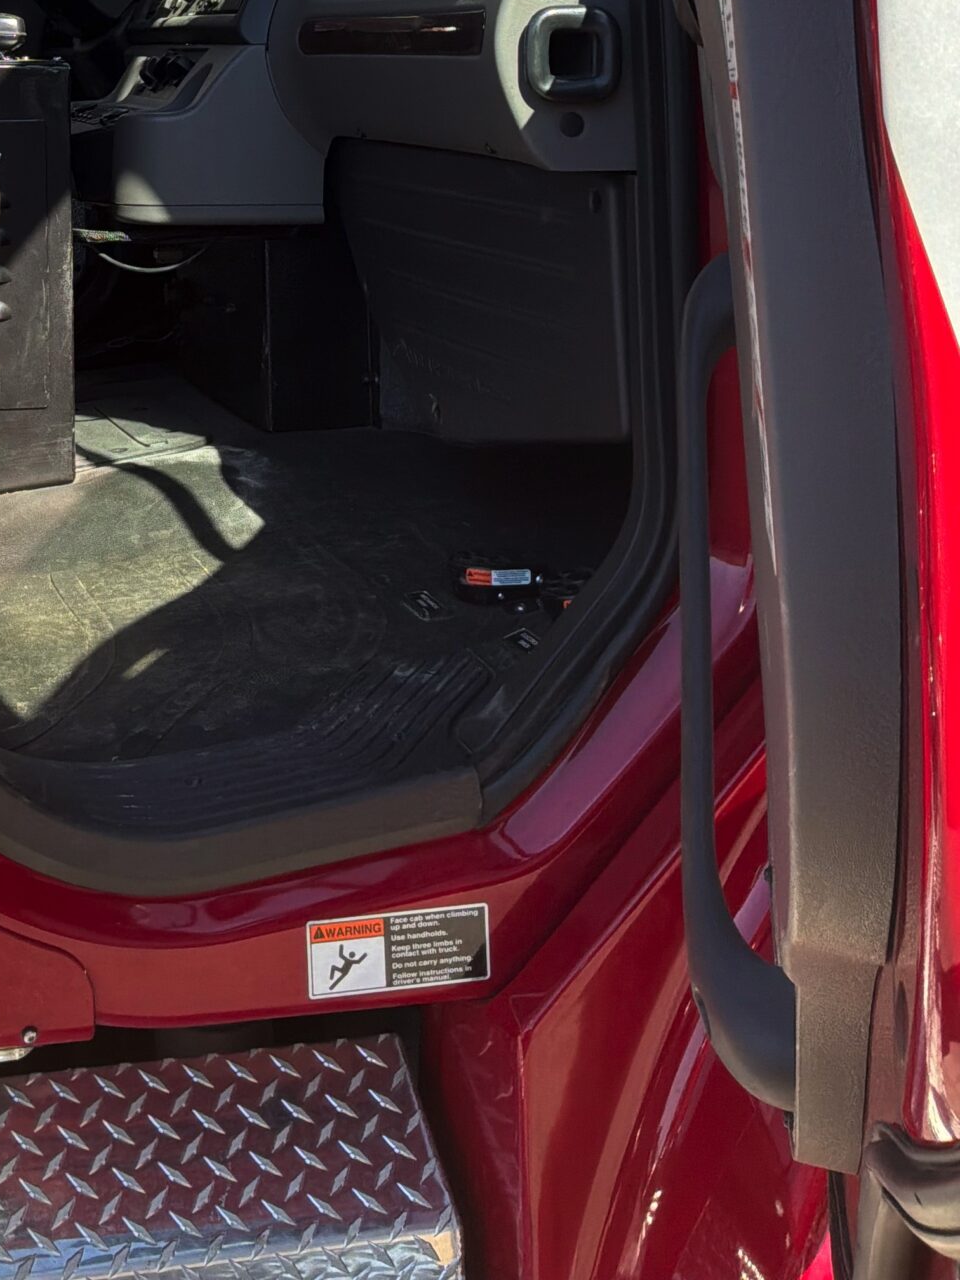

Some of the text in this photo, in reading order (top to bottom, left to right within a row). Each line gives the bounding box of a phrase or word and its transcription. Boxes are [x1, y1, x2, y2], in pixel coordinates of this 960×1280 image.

[446, 910, 478, 918] climbing
[325, 923, 382, 938] WARNING
[391, 944, 411, 952] Keep
[412, 941, 431, 949] three
[392, 950, 419, 958] contact
[419, 959, 437, 967] carry
[440, 955, 473, 964] anything.
[392, 971, 417, 979] Follow
[419, 966, 463, 976] instructions
